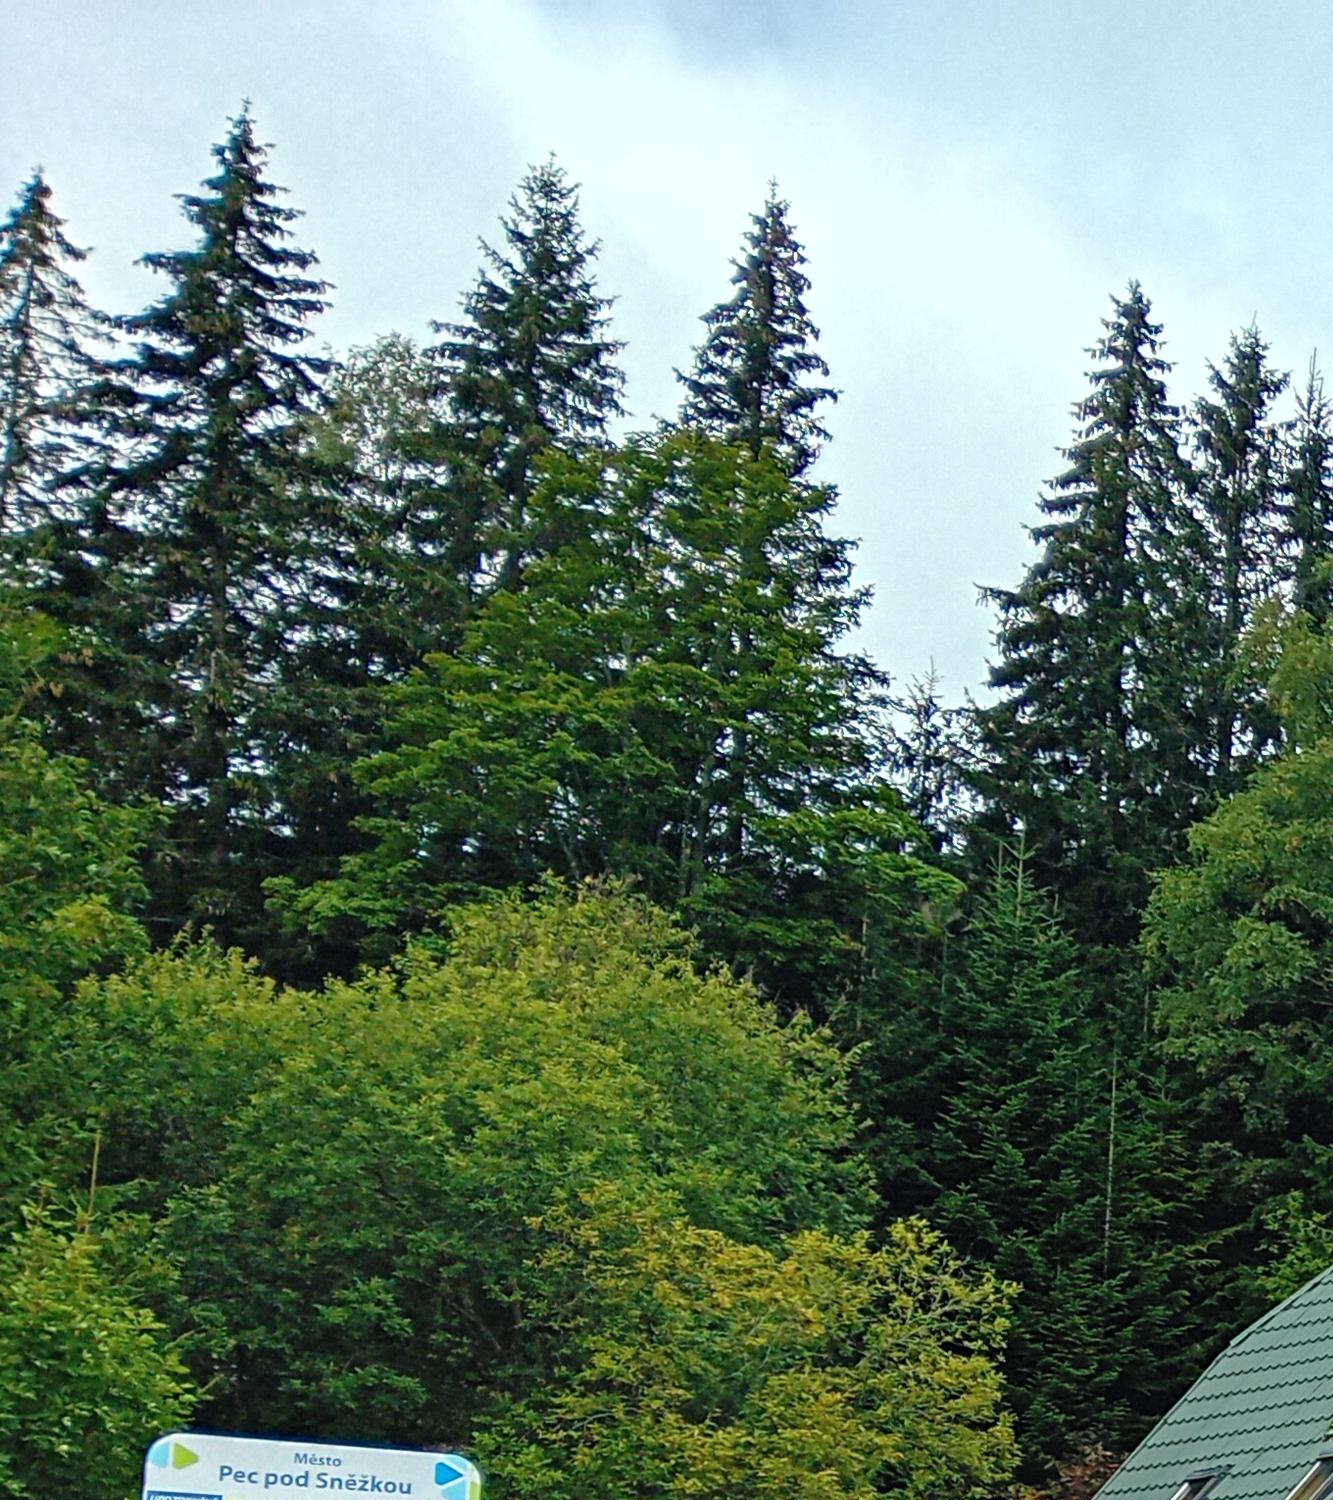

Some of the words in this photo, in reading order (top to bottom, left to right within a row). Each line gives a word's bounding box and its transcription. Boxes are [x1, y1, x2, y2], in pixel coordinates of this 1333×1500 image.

[294, 1452, 342, 1468] Město
[218, 1465, 258, 1485] Pec
[263, 1470, 309, 1489] pod
[315, 1471, 412, 1495] Sněžkou
